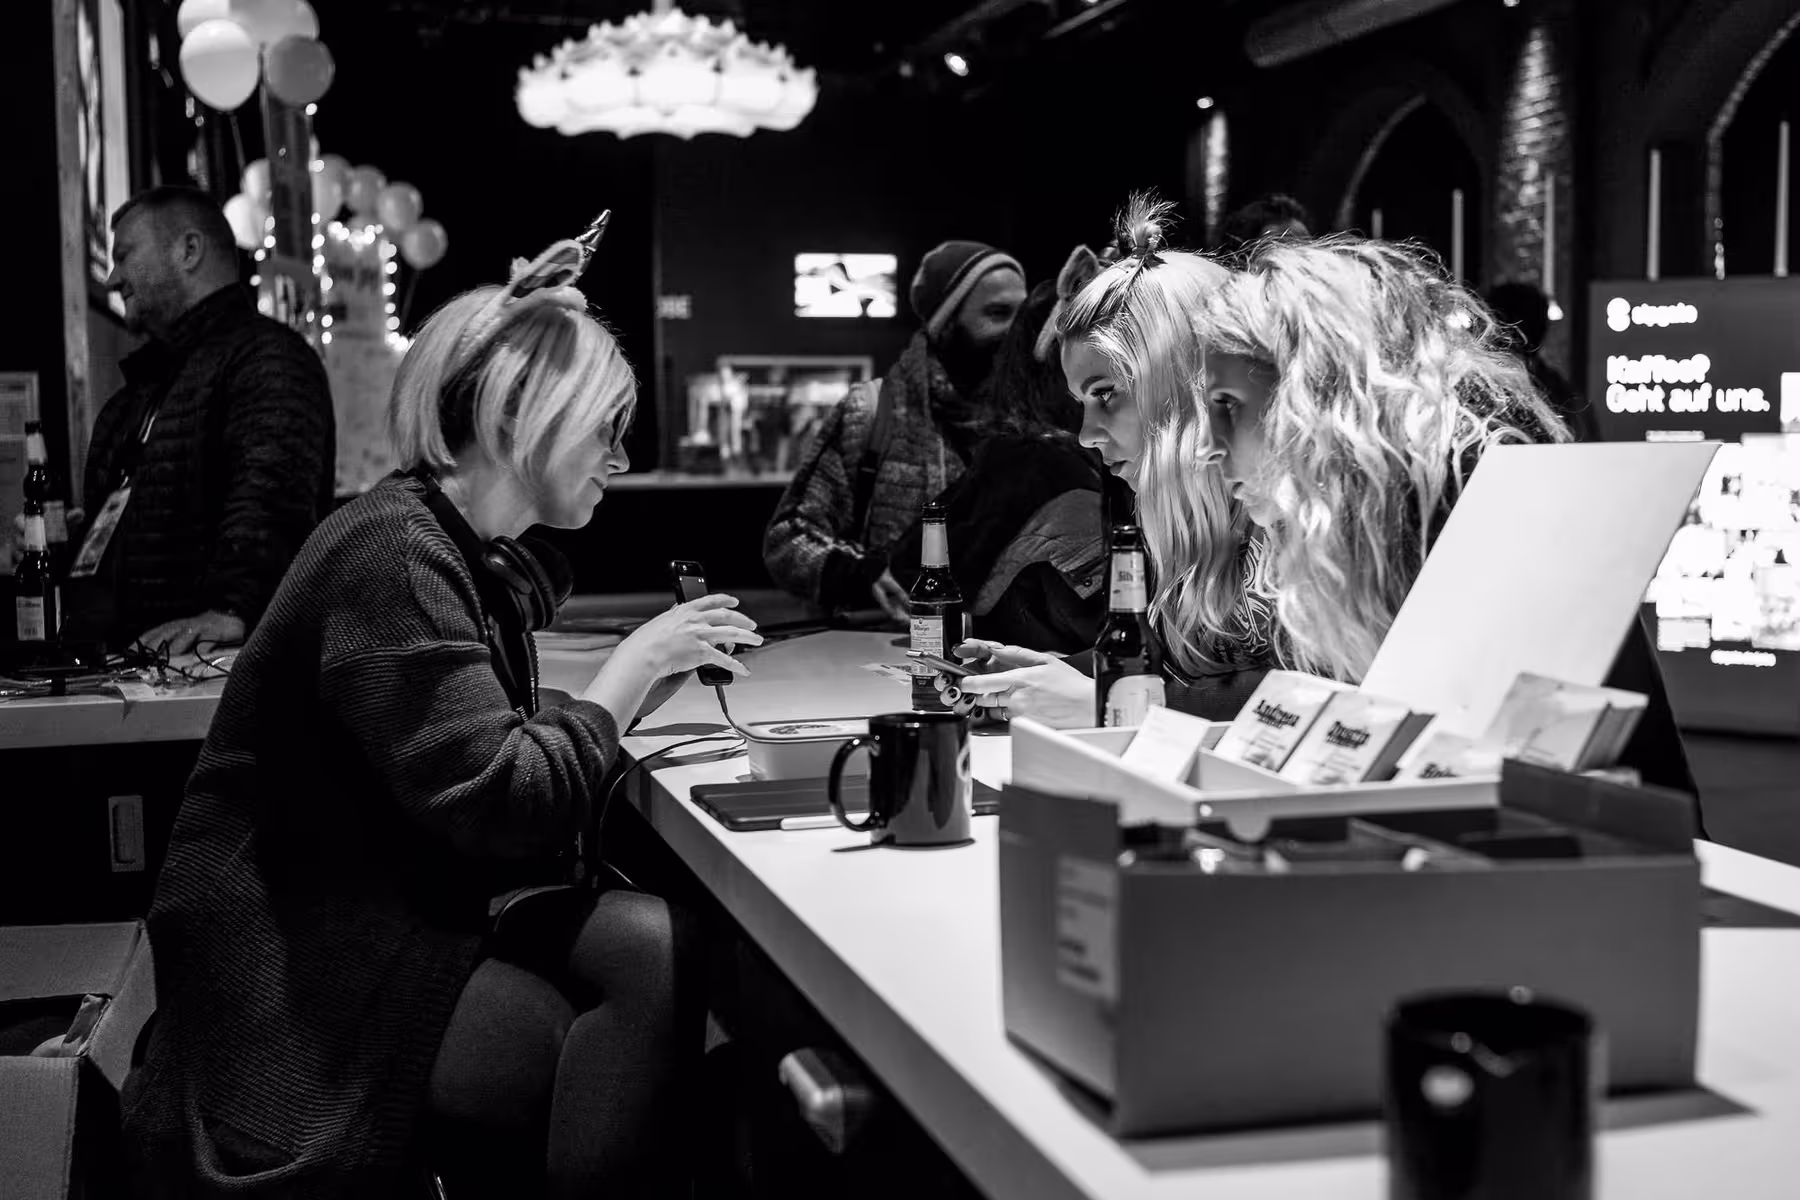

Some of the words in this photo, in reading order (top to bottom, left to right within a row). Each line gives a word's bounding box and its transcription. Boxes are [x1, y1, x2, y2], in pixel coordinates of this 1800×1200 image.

[1606, 383, 1665, 413] Geht
[1669, 382, 1712, 412] auf
[1716, 387, 1770, 412] uns.
